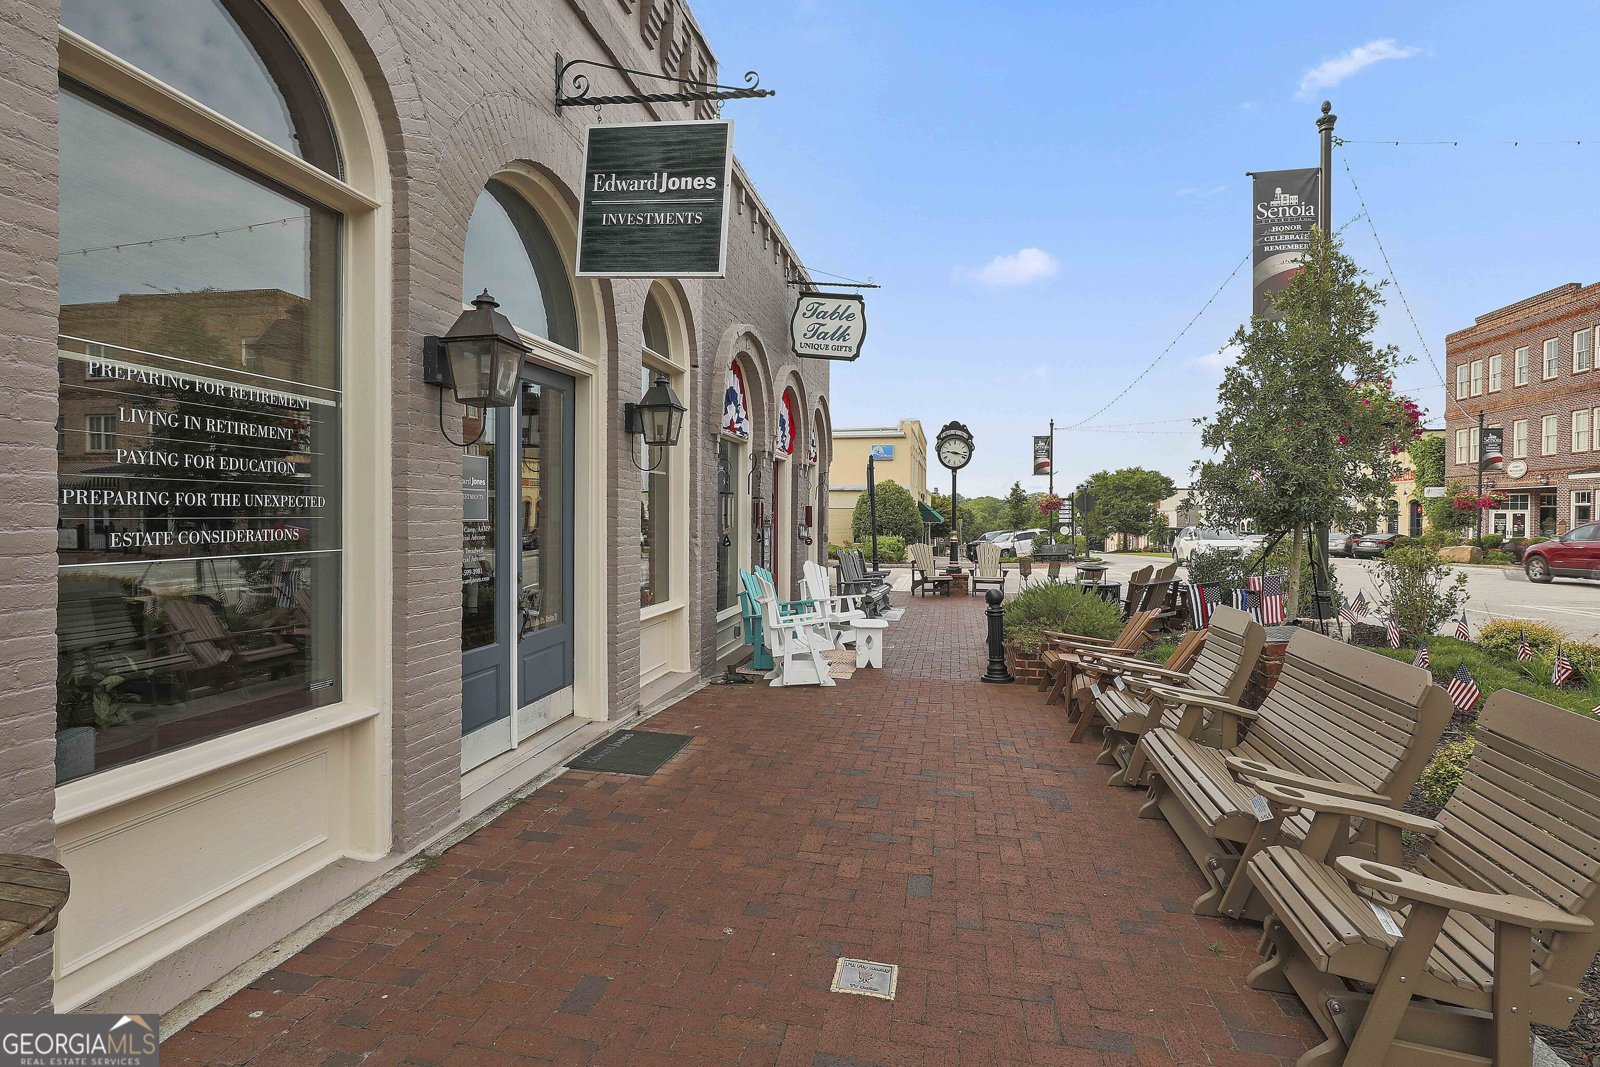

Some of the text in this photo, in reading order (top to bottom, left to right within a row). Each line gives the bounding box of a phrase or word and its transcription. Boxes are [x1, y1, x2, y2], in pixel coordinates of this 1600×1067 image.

[601, 212, 703, 226] INVESTMENTS
[1256, 201, 1316, 220] Senoia
[1264, 233, 1310, 242] CELEBRATE
[1271, 224, 1302, 232] HONOR
[1264, 243, 1310, 252] REMEMBER
[802, 301, 856, 322] Table
[803, 322, 852, 342] Talk
[800, 342, 853, 352] UNIQUE GIFTS
[88, 360, 312, 411] PREPARING FOR RETIREMENT
[118, 407, 294, 441] LIVING IN RETIREMENT
[116, 449, 296, 474] PAYING FOR EDUCATION
[62, 489, 326, 508] PREPARING FOR THE UNEXPECTED
[110, 528, 299, 548] ESTATE CONSIDERATIONS
